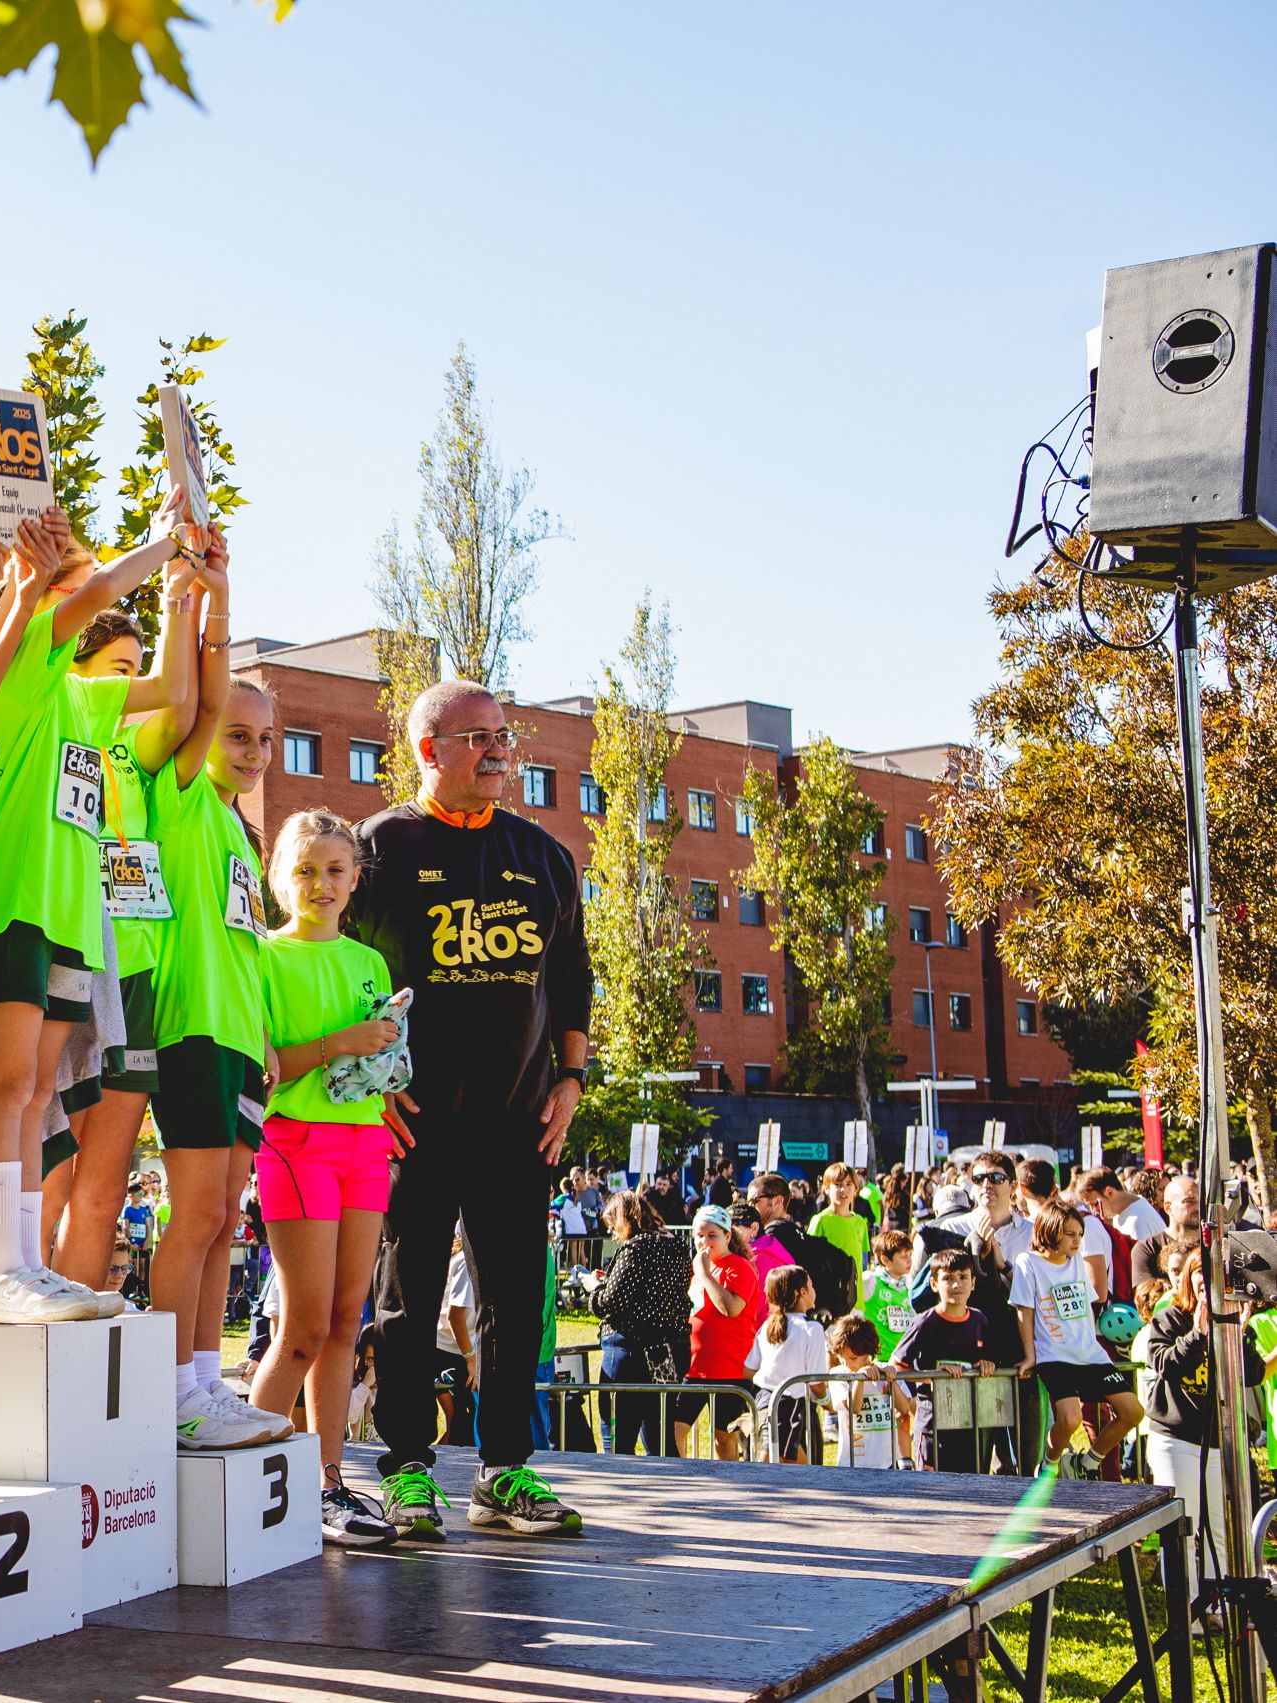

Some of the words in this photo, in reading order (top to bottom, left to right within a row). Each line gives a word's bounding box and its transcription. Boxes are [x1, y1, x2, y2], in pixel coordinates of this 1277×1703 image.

[2, 463, 19, 475] Sant
[19, 466, 40, 478] Cugat
[67, 756, 100, 781] CROS
[114, 866, 145, 881] CROS
[418, 869, 443, 878] OMET
[507, 899, 519, 907] de
[481, 910, 501, 920] Sant
[502, 905, 528, 916] Cugat
[432, 920, 543, 967] CROS
[856, 1411, 891, 1424] 2898
[104, 1480, 156, 1511] Diputació
[262, 1453, 289, 1530] 3
[104, 1509, 156, 1535] Barcelona
